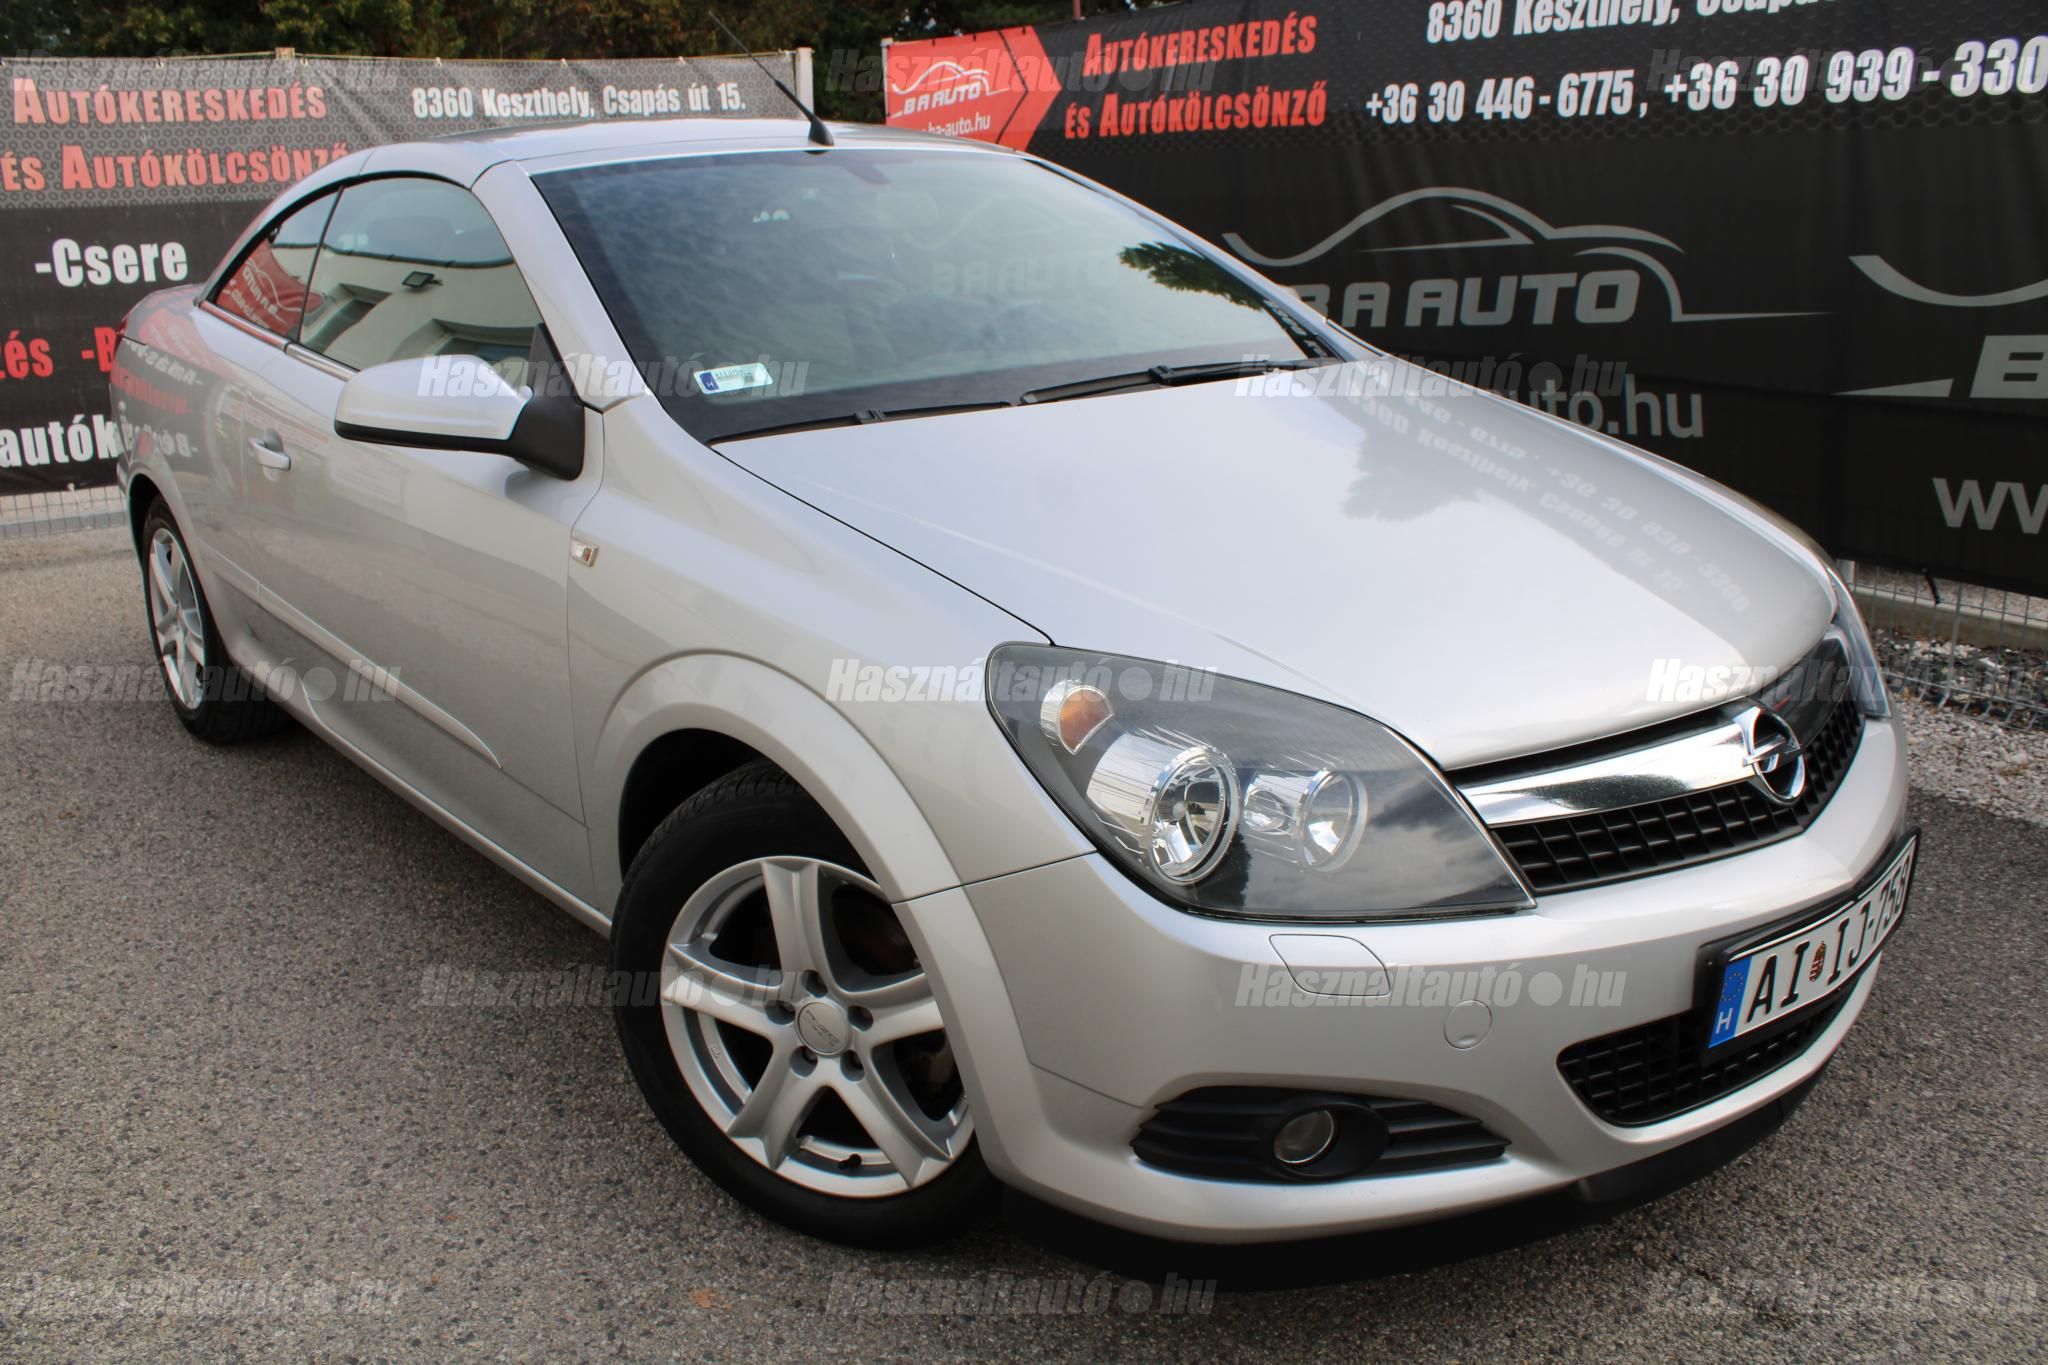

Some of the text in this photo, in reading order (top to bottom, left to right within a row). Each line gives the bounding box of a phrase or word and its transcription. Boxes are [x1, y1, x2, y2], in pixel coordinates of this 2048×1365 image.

[1426, 0, 1501, 44] 8360
[412, 80, 747, 119] 8360 Keszthely, Csapás út 15.
[902, 81, 983, 115] BA AUTO
[1366, 82, 1418, 125] +36
[1427, 80, 1465, 123] 30
[1664, 60, 1738, 111] +36
[1753, 54, 1810, 107] 30
[34, 237, 189, 288] -Csere
[1404, 268, 1641, 328] AUTO
[0, 329, 54, 379] és
[1715, 1007, 1734, 1034] H
